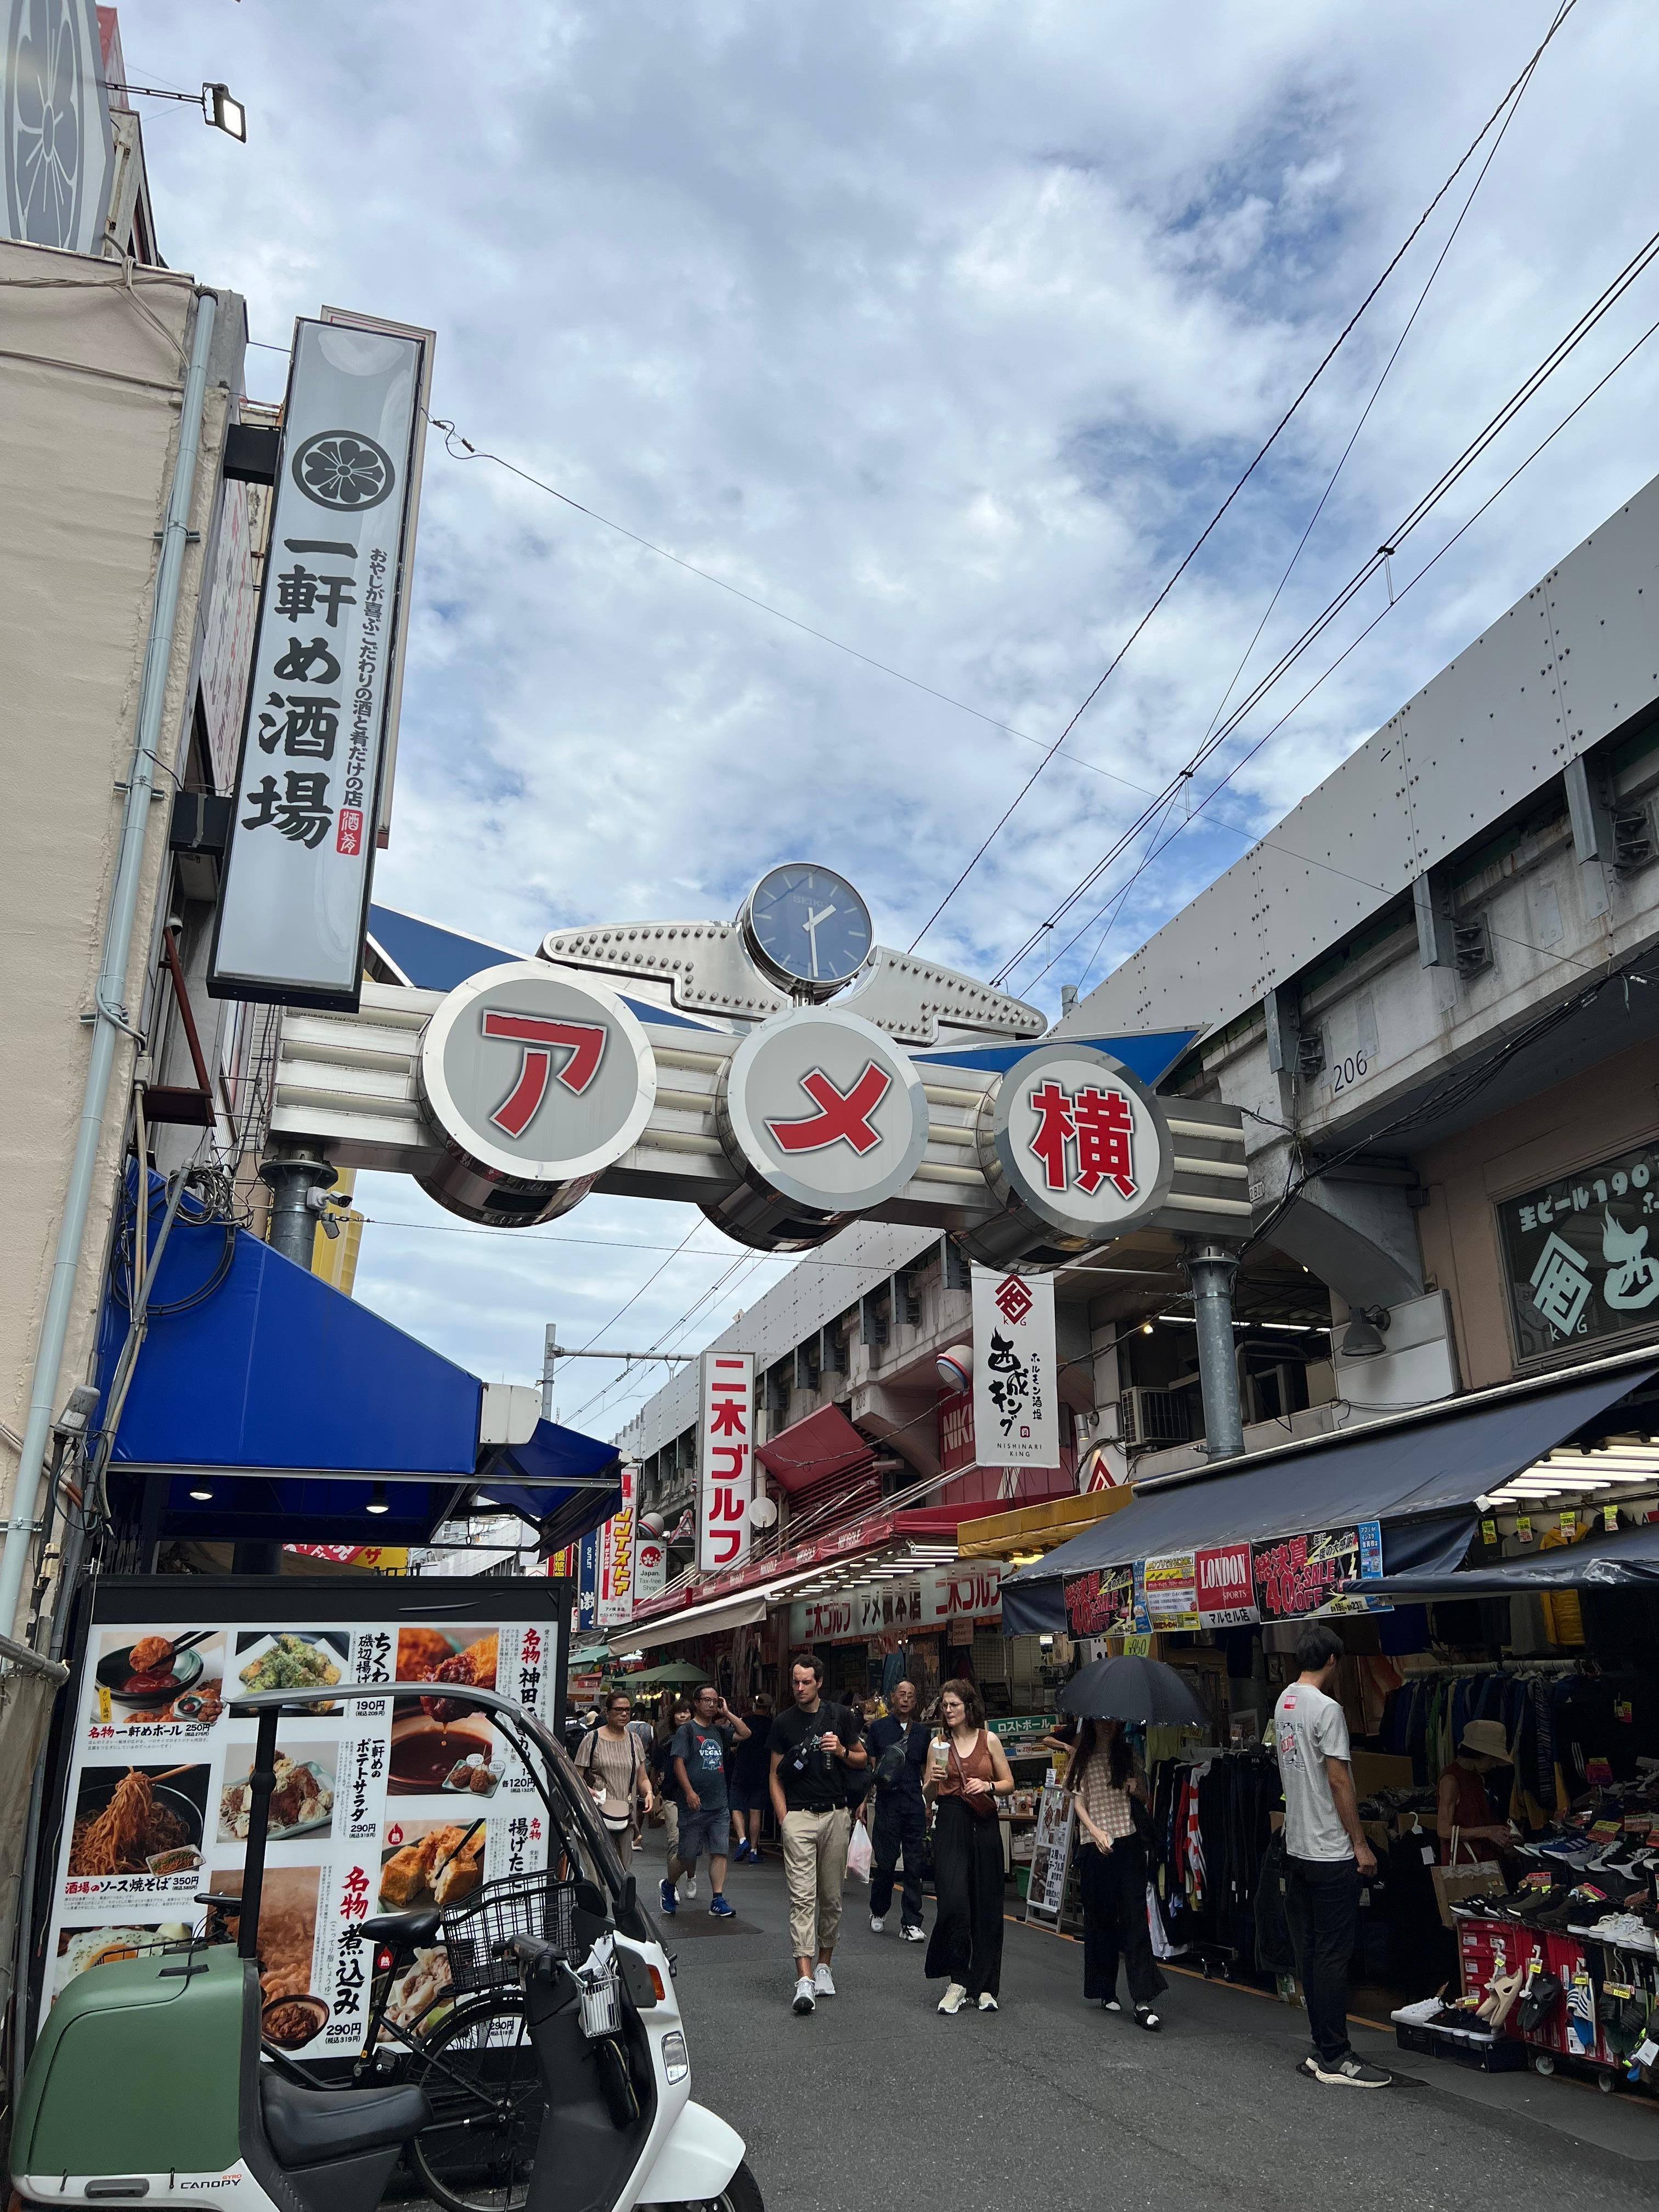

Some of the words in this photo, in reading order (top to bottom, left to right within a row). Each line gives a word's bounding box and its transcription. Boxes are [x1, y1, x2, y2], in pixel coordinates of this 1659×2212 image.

[342, 548, 387, 808] おやじが喜ぶこだわりの酒と肴だけの店
[241, 538, 358, 850] 一軒め酒場
[792, 895, 829, 907] SEIKO
[1333, 1049, 1368, 1093] 206
[1030, 1352, 1043, 1421] ホルモン酒場
[856, 1391, 866, 1410] 208
[708, 1359, 748, 1564] 二木ゴルフ
[1200, 1553, 1246, 1589] LONDON
[1254, 1534, 1308, 1584] 総決算
[1303, 1558, 1336, 1589] SALE
[1222, 1589, 1247, 1600] SPORTS
[1295, 1587, 1324, 1611] OFF
[1091, 1612, 1110, 1632] OFF
[1209, 1607, 1251, 1624] マルセル店
[371, 1632, 392, 1683] ちくわ
[521, 1628, 541, 1664] 名物
[101, 1690, 110, 1720] カレー風味
[356, 1700, 386, 1711] 190円
[185, 1724, 211, 1732] 250円
[997, 1718, 1051, 1733] ロストボール
[370, 1739, 386, 1778] 一軒めの
[350, 1737, 371, 1822] ポテトサラダ
[350, 1823, 376, 1833] 290円
[391, 1830, 401, 1843] 熱
[529, 1817, 541, 1841] 名物
[64, 1877, 172, 1894] 酒場のソース焼そば
[172, 1876, 199, 1886] 350円
[326, 2022, 362, 2036] 290円
[180, 2179, 241, 2189] CANOPY
